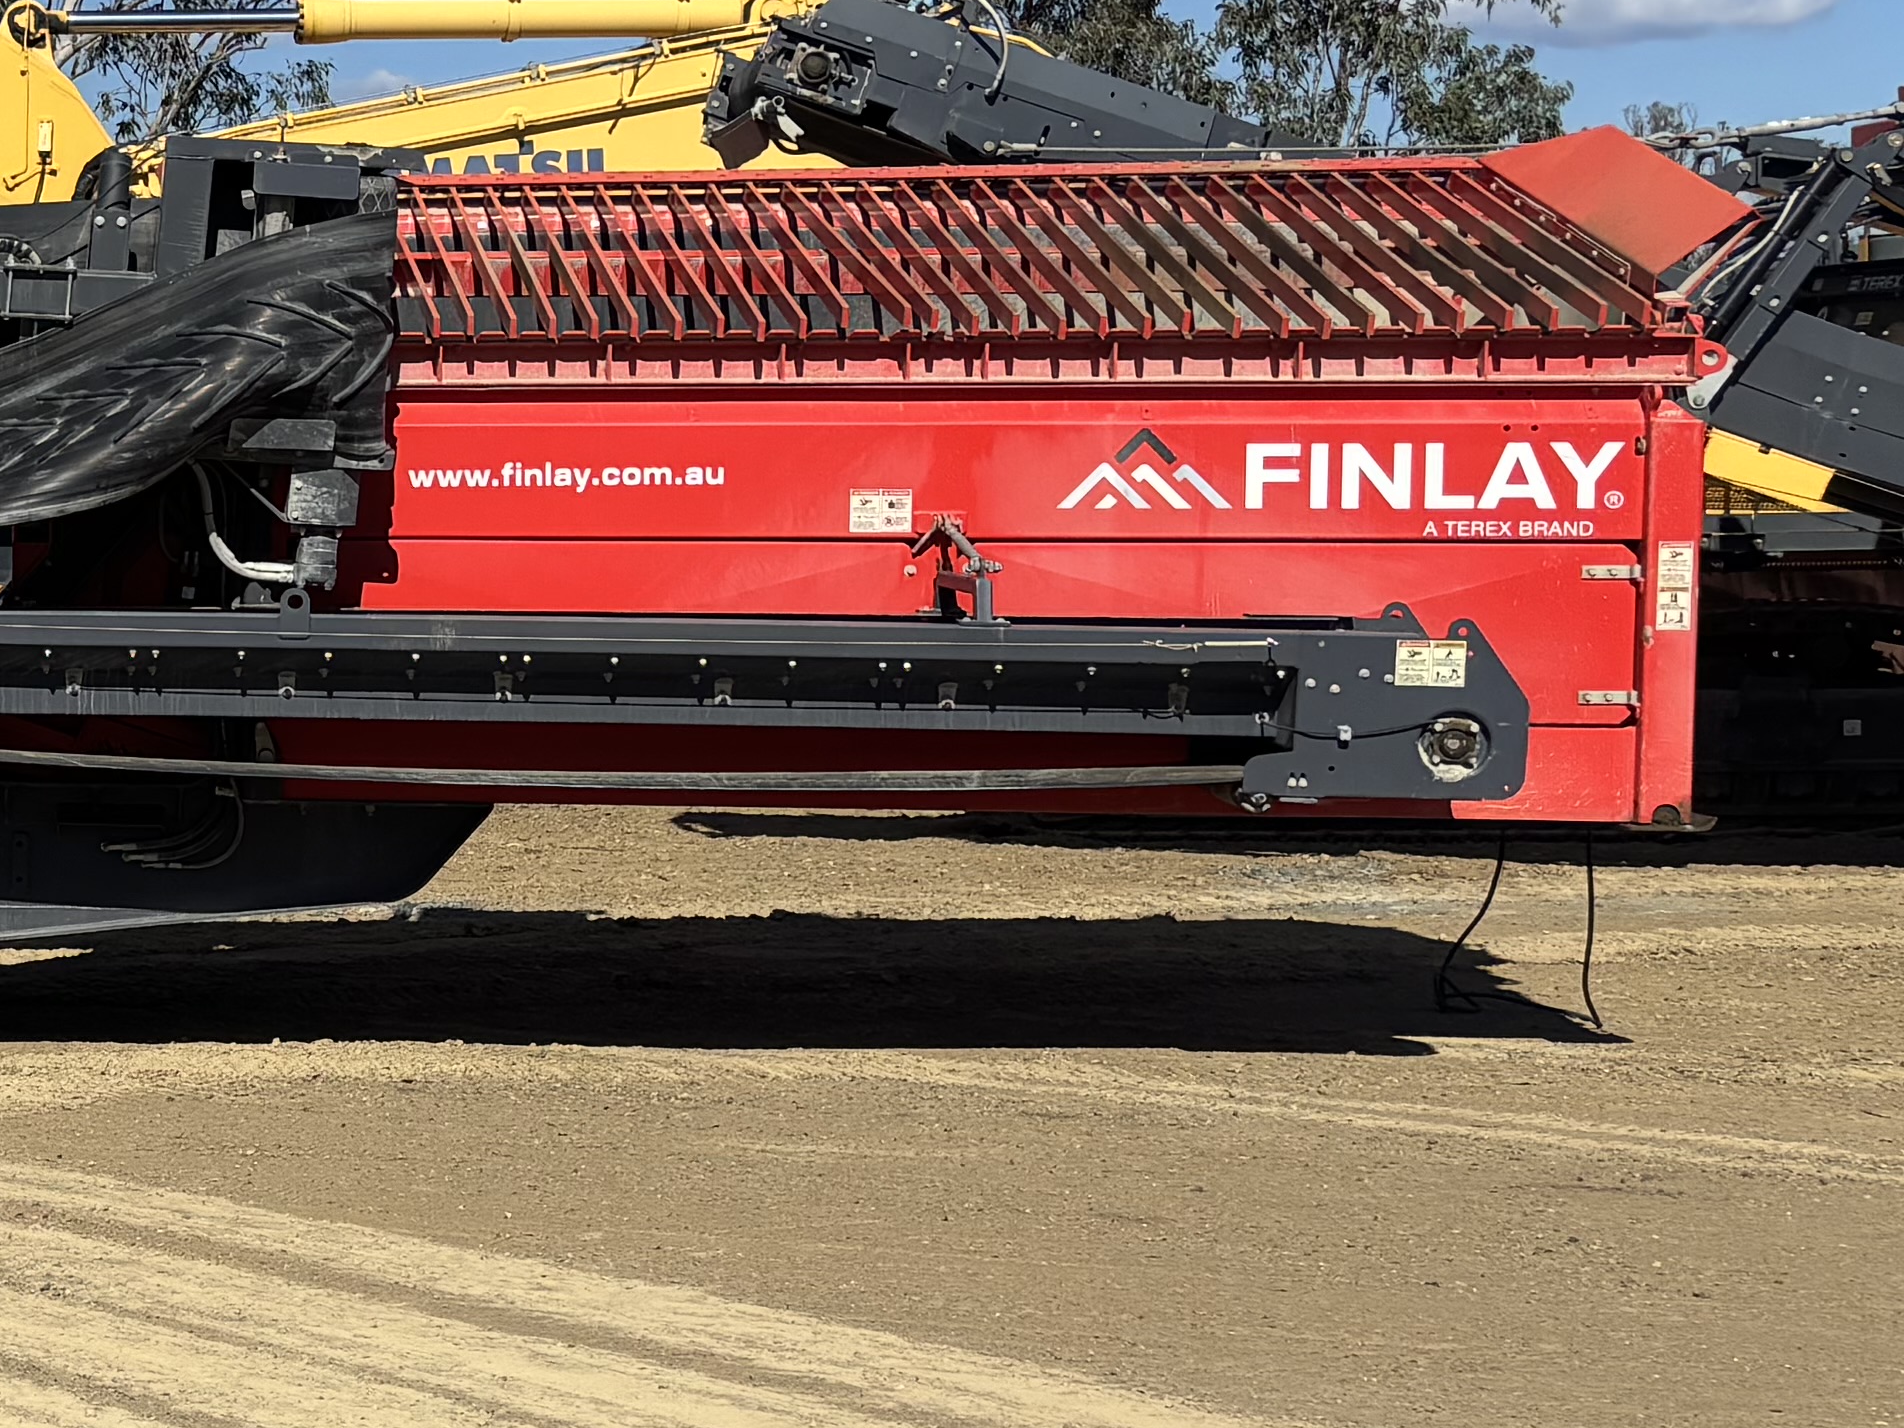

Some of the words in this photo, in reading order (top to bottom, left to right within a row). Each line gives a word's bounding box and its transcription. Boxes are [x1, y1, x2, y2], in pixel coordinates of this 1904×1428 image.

[407, 461, 725, 493] www.finlay.com.au
[1423, 522, 1438, 537] A
[1444, 521, 1512, 537] TEREX
[1519, 521, 1594, 537] BRAND
